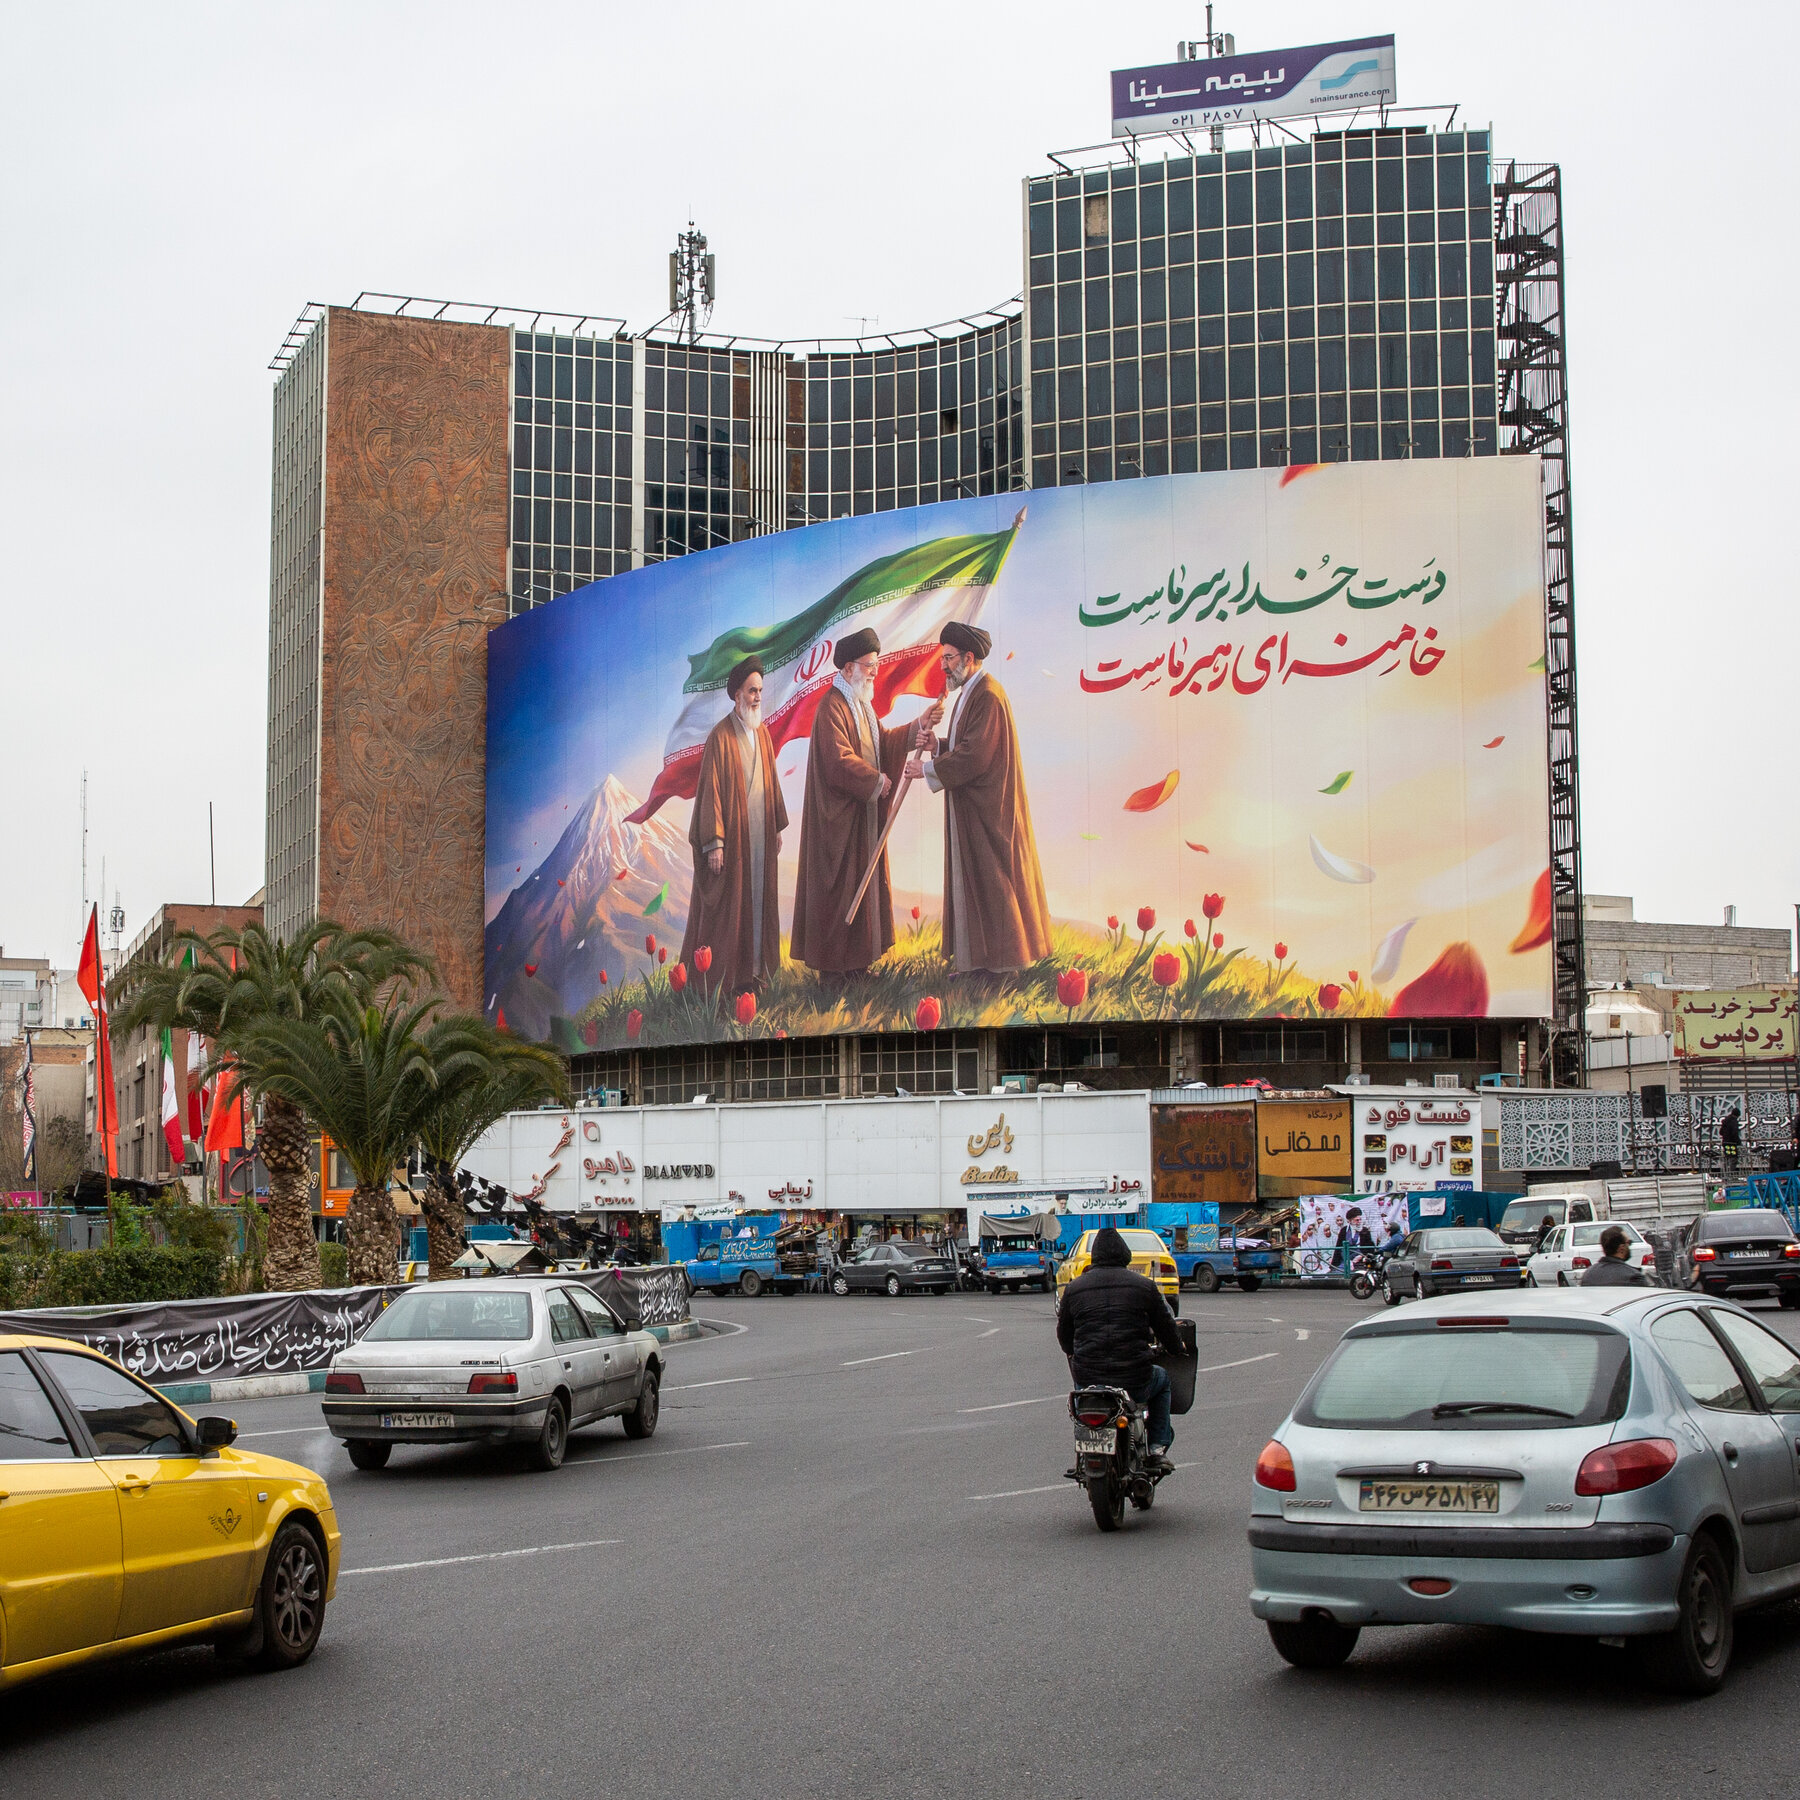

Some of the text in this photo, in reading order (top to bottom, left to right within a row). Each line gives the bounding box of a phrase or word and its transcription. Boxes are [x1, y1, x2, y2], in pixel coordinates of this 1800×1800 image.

[1129, 67, 1285, 108] بیمه سینا
[1309, 88, 1390, 104] sinainsurance.com
[1683, 997, 1799, 1019] مرکز خرید
[1700, 1026, 1784, 1050] پردیس
[1307, 1110, 1343, 1120] فروشگاه
[1367, 1100, 1471, 1130] فست فود
[967, 1112, 1015, 1157] بالین
[1390, 1140, 1447, 1169] آرام
[960, 1165, 1019, 1185] Balin
[1363, 1180, 1394, 1193] VIP
[1082, 1198, 1128, 1209] موکب برادران
[1285, 1498, 1333, 1509] PEUGEOT
[1544, 1502, 1574, 1512] 206
